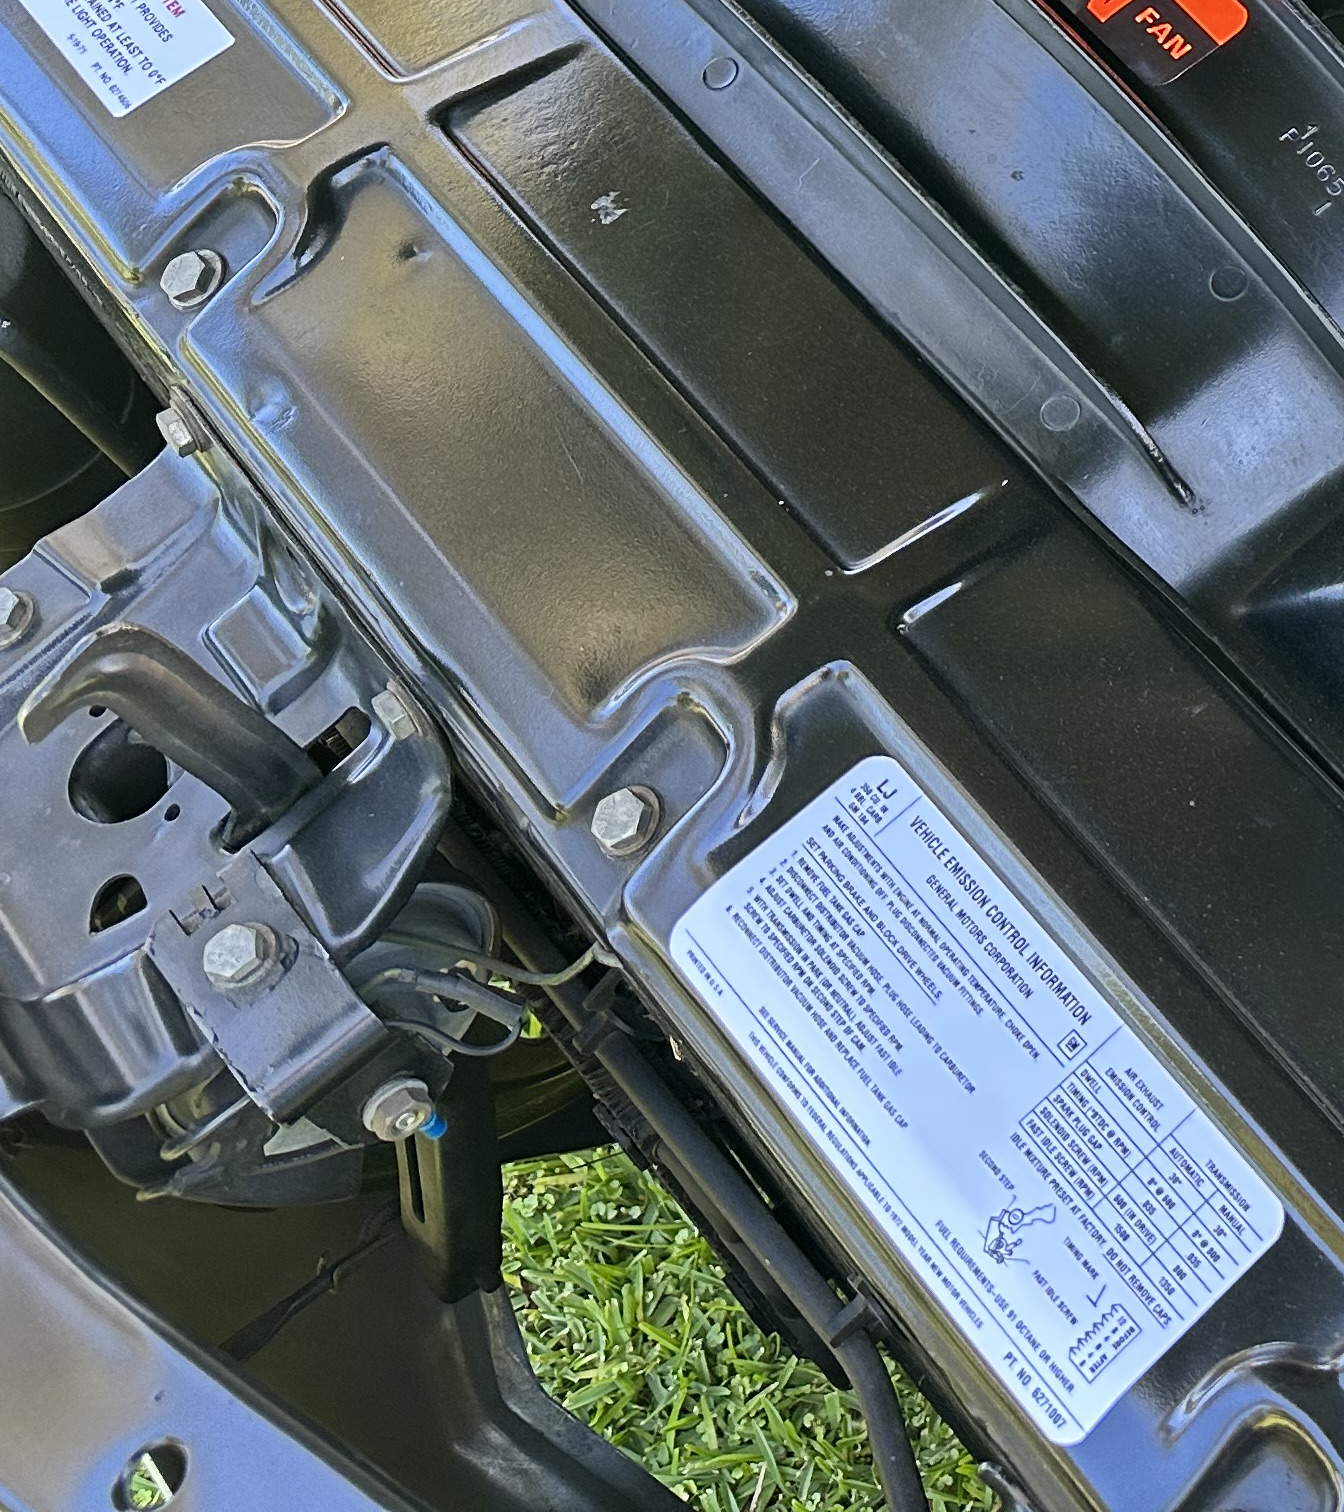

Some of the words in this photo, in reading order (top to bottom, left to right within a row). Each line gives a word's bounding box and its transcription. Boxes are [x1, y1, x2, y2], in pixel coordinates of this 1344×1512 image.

[69, 3, 97, 30] LIGHT
[89, 26, 136, 76] OPERATION.
[105, 19, 123, 34] AT
[114, 30, 144, 59] LEAST
[136, 55, 154, 72] TO
[134, 1, 174, 43] PROVIDES
[1134, 6, 1192, 60] FAN
[875, 777, 898, 801] LJ
[805, 836, 821, 853] SET
[816, 850, 846, 883] PARKING
[841, 879, 866, 907] BRAKE
[861, 903, 879, 923] AND
[875, 919, 900, 948] BLOCK
[895, 944, 918, 969] DRIVE
[913, 965, 945, 1002] WHEELS.
[907, 814, 950, 861] VEHICLE
[942, 854, 992, 909] EMISSION
[984, 902, 1033, 957] CONTROL
[1025, 950, 1093, 1026] INFORMATION
[924, 873, 960, 912] GENERAL
[953, 907, 988, 945] MOTORS
[982, 940, 1035, 999] CORPORATION
[1079, 1068, 1102, 1094] DWELL
[1103, 1066, 1135, 1103] EMISSION
[1130, 1097, 1162, 1132] CONTROL
[1123, 1066, 1138, 1083] AIR
[1133, 1078, 1164, 1112] EXHAUST
[1037, 1105, 1071, 1144] SOLENOID
[1065, 1138, 1091, 1168] SCREW
[1085, 1162, 1109, 1189] (RPM)
[1051, 1093, 1075, 1119] SPARK
[1070, 1115, 1091, 1138] PLUG
[1086, 1133, 1103, 1152] GAP
[1024, 1117, 1044, 1140] FAST
[1038, 1134, 1057, 1156] IDLE
[1052, 1150, 1078, 1180] SCREW
[1072, 1174, 1096, 1202] (RPM)
[1167, 1145, 1205, 1188] AUTOMATIC
[1203, 1158, 1252, 1213] TRANSMISSION
[1009, 1131, 1027, 1151] IDLE
[1022, 1147, 1052, 1181] MIXTURE
[1047, 1177, 1073, 1207] PRESET
[1068, 1202, 1081, 1217] AT
[1076, 1212, 1110, 1251] FACTORY.
[1104, 1246, 1119, 1262] DO
[1114, 1257, 1131, 1277] NOT
[1127, 1272, 1156, 1307] REMOVE
[1151, 1302, 1175, 1329] CAPS.
[1217, 1203, 1246, 1236] MANUAL
[932, 1218, 953, 1242] FUEL
[947, 1236, 1010, 1313] REQUIREMENTS-USE
[1004, 1308, 1018, 1323] 91
[1013, 1318, 1042, 1353] OCTANE
[1036, 1347, 1052, 1366] OR
[1046, 1360, 1078, 1398] HIGHER.
[1001, 1350, 1020, 1372] PT.
[1014, 1367, 1035, 1391] NO.
[1029, 1385, 1067, 1431] 6271007
